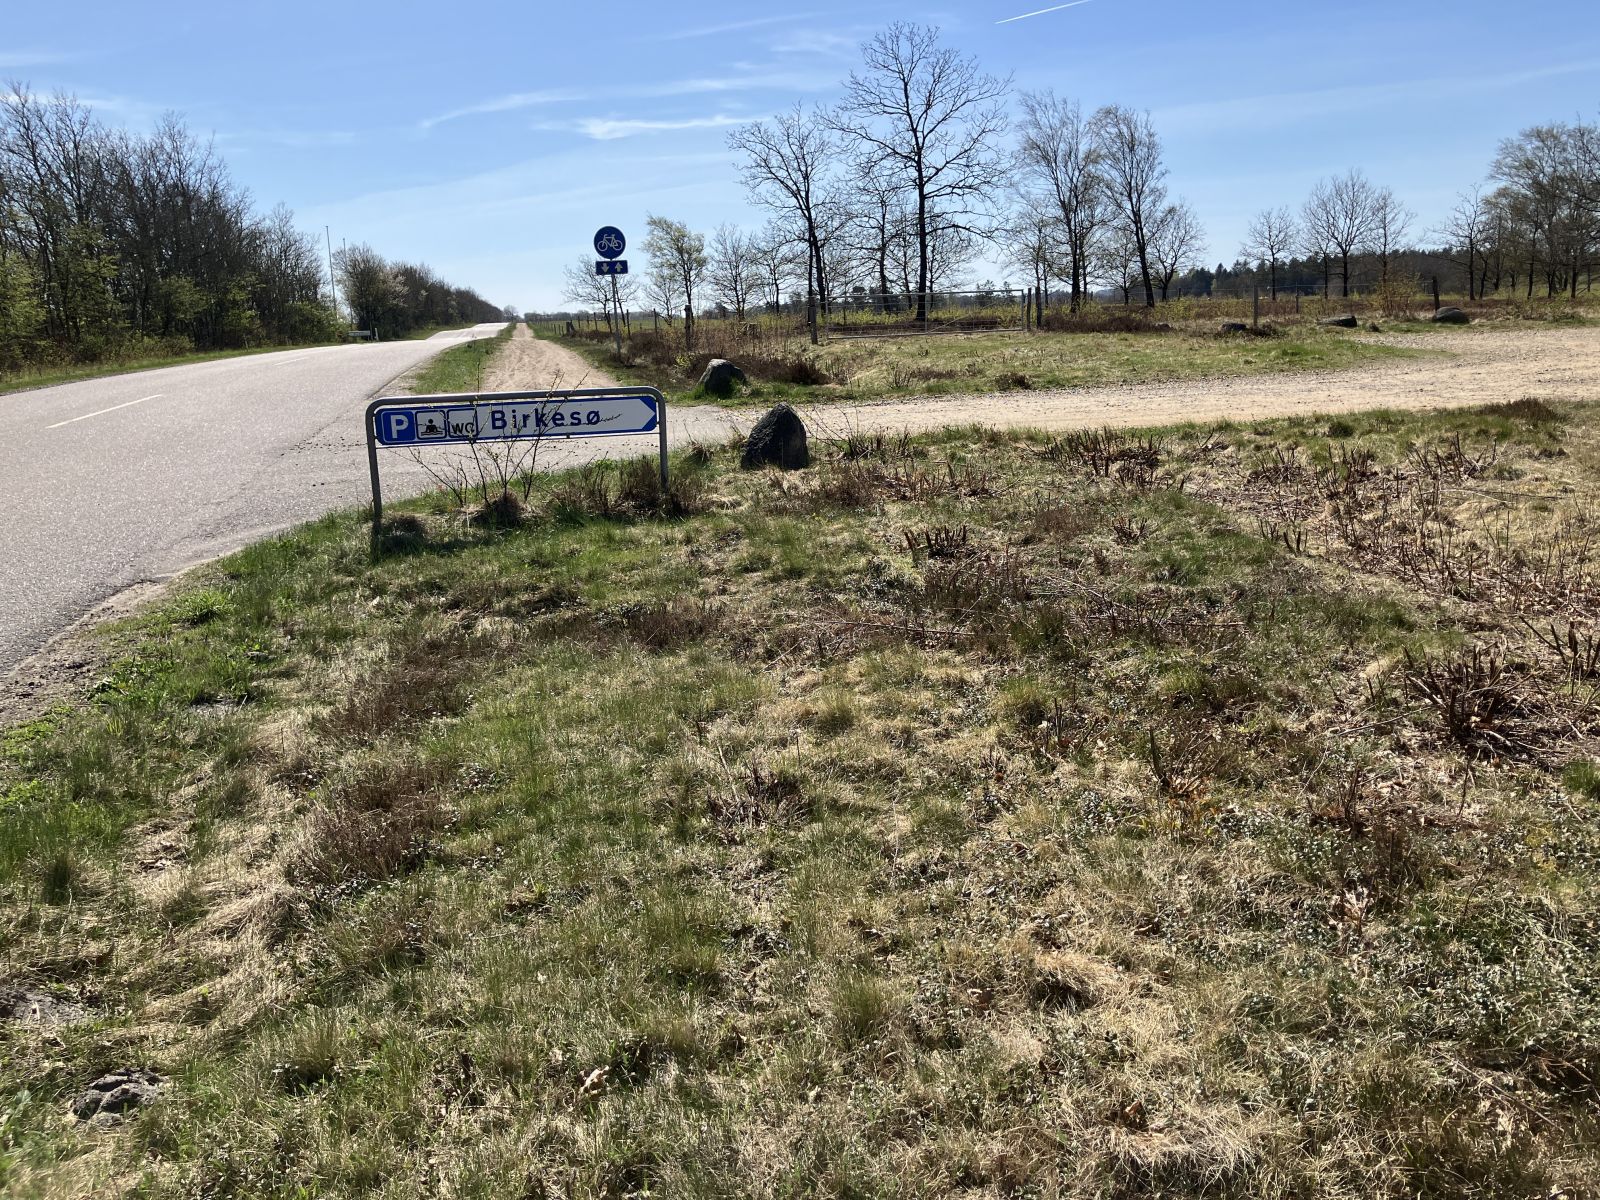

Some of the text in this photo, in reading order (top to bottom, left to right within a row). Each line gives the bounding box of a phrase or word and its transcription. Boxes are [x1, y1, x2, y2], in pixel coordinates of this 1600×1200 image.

[390, 408, 600, 439] P WC Birkesø
